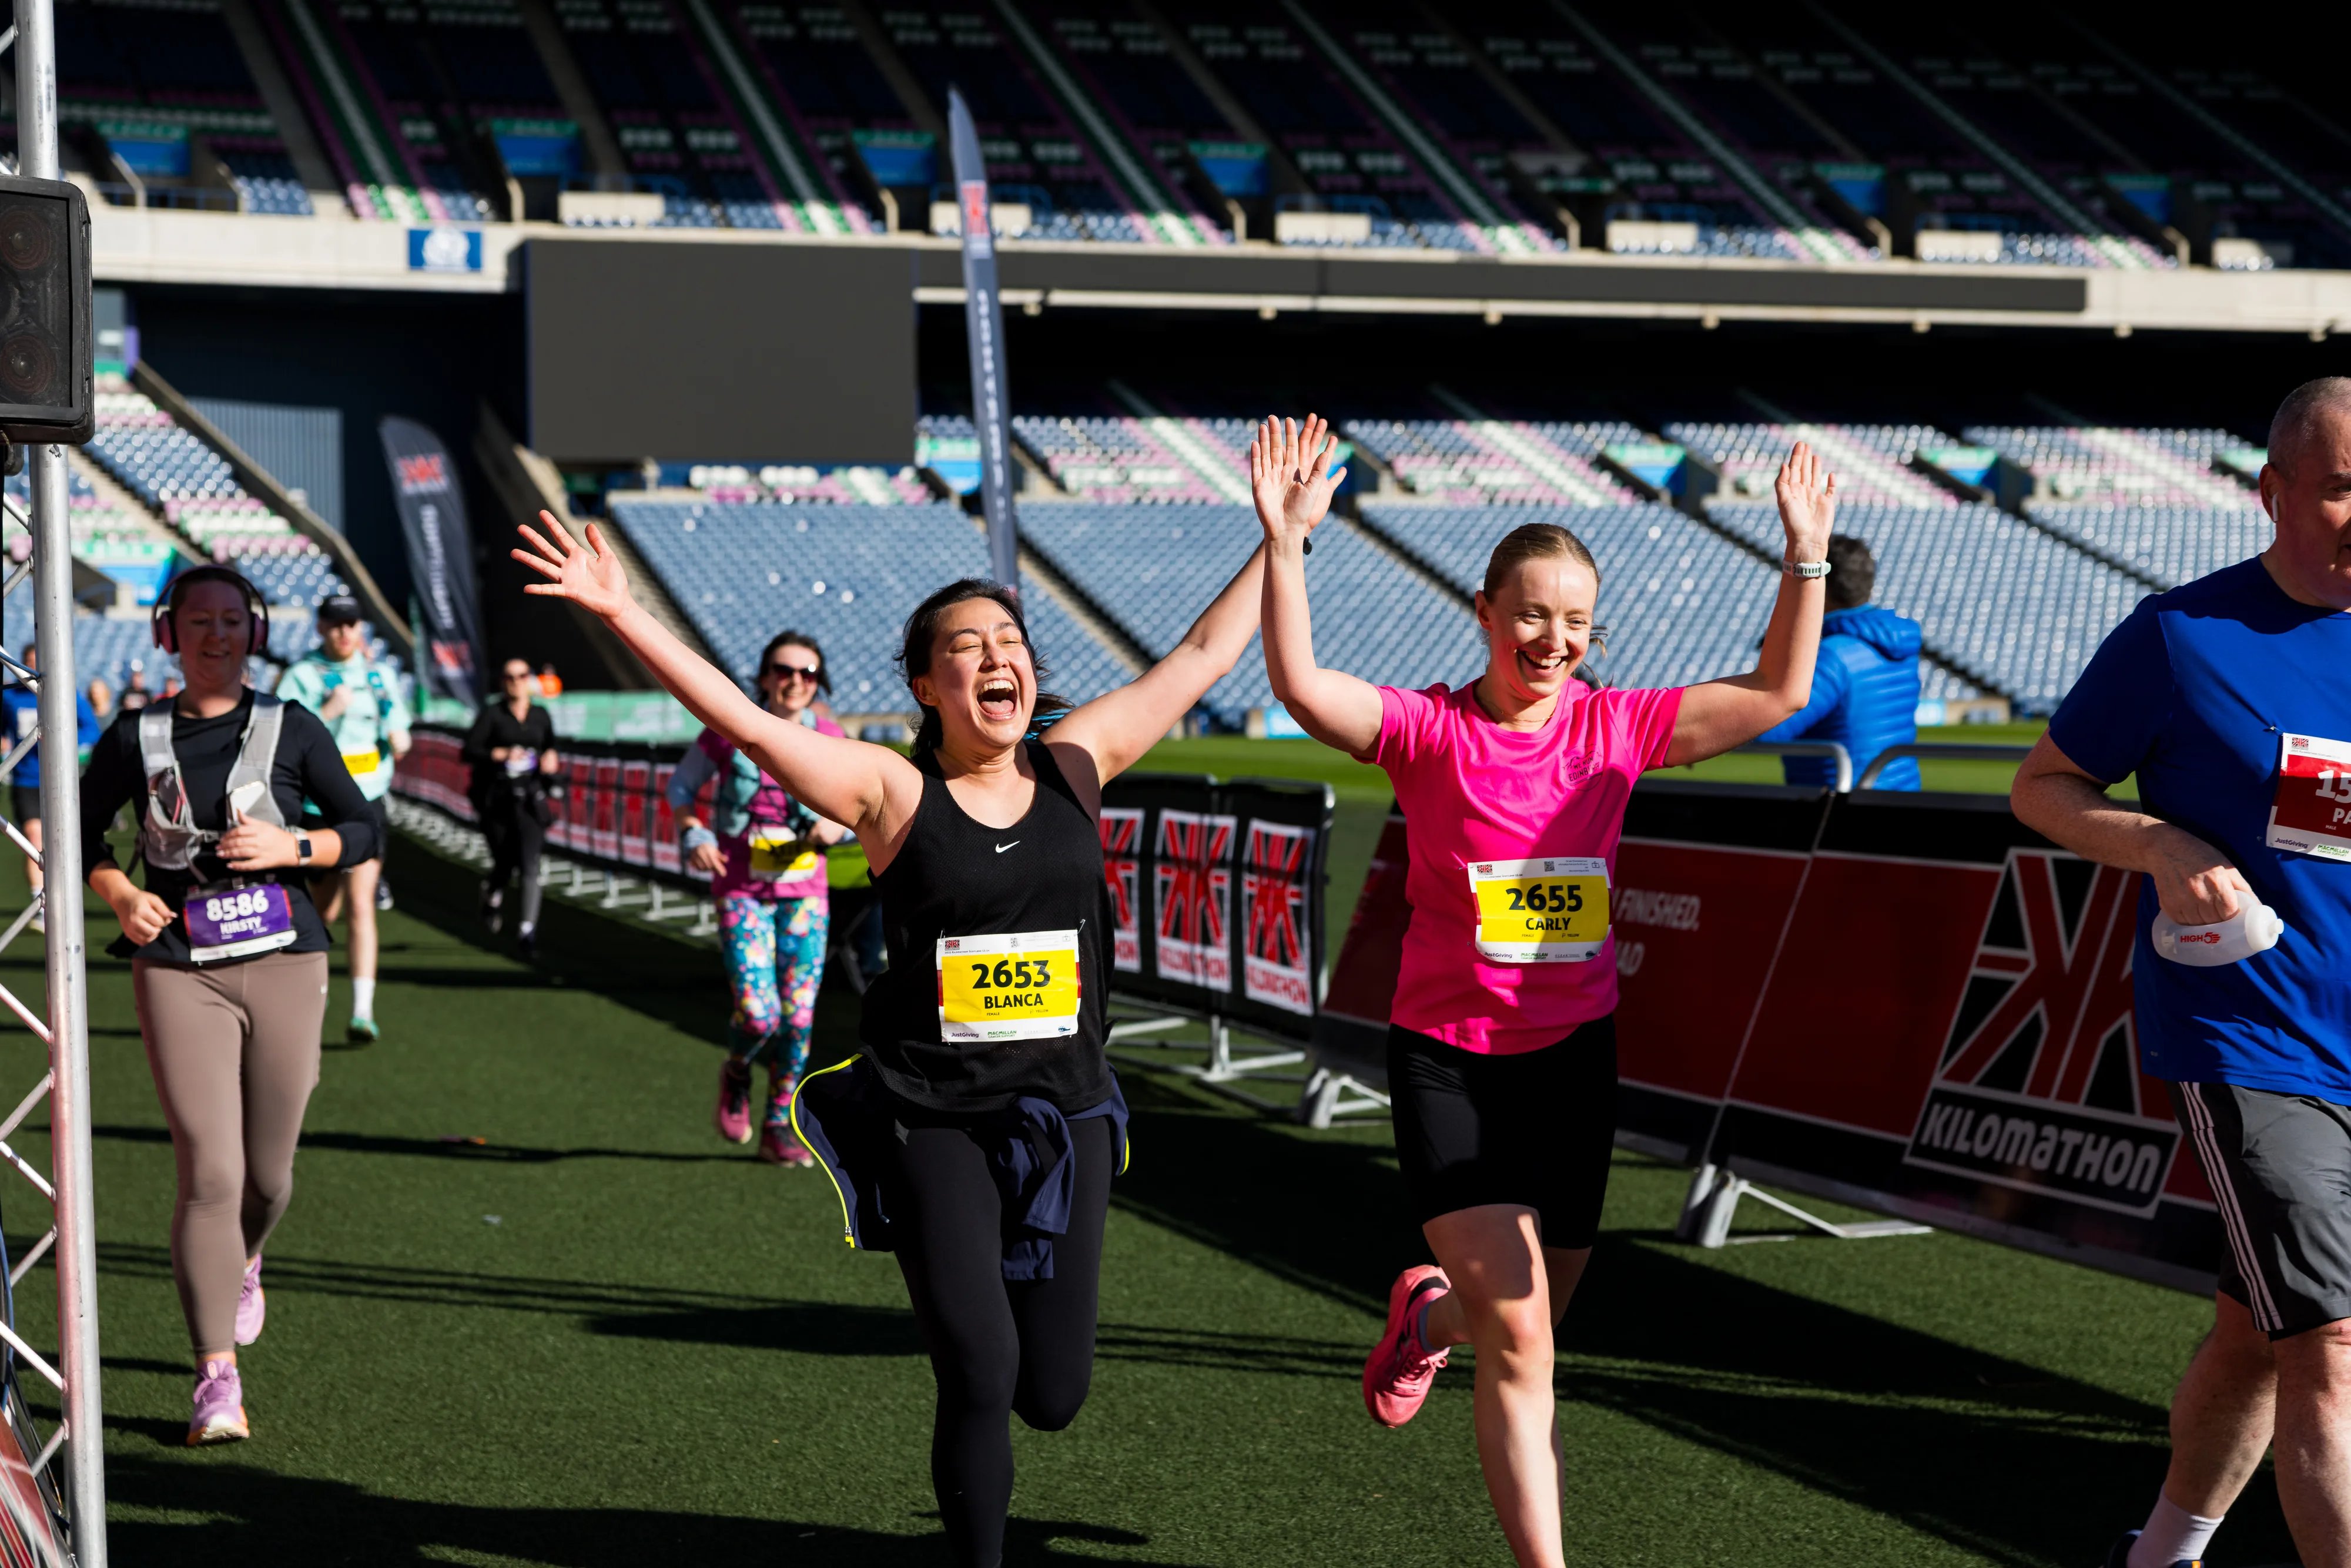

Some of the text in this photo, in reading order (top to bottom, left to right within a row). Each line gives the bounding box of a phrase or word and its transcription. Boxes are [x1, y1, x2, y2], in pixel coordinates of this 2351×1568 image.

[1582, 756, 1594, 766] RUN
[2275, 837, 2309, 849] JustGiving
[2317, 845, 2349, 854] MACMILLAN
[1506, 883, 1583, 912] 2655
[206, 889, 269, 922] 8586
[220, 915, 263, 934] KIRSTY
[1526, 917, 1572, 930] CARLY
[2181, 932, 2216, 944] HIGH5
[972, 960, 1051, 989] 2653
[984, 993, 1044, 1009] BLANCA
